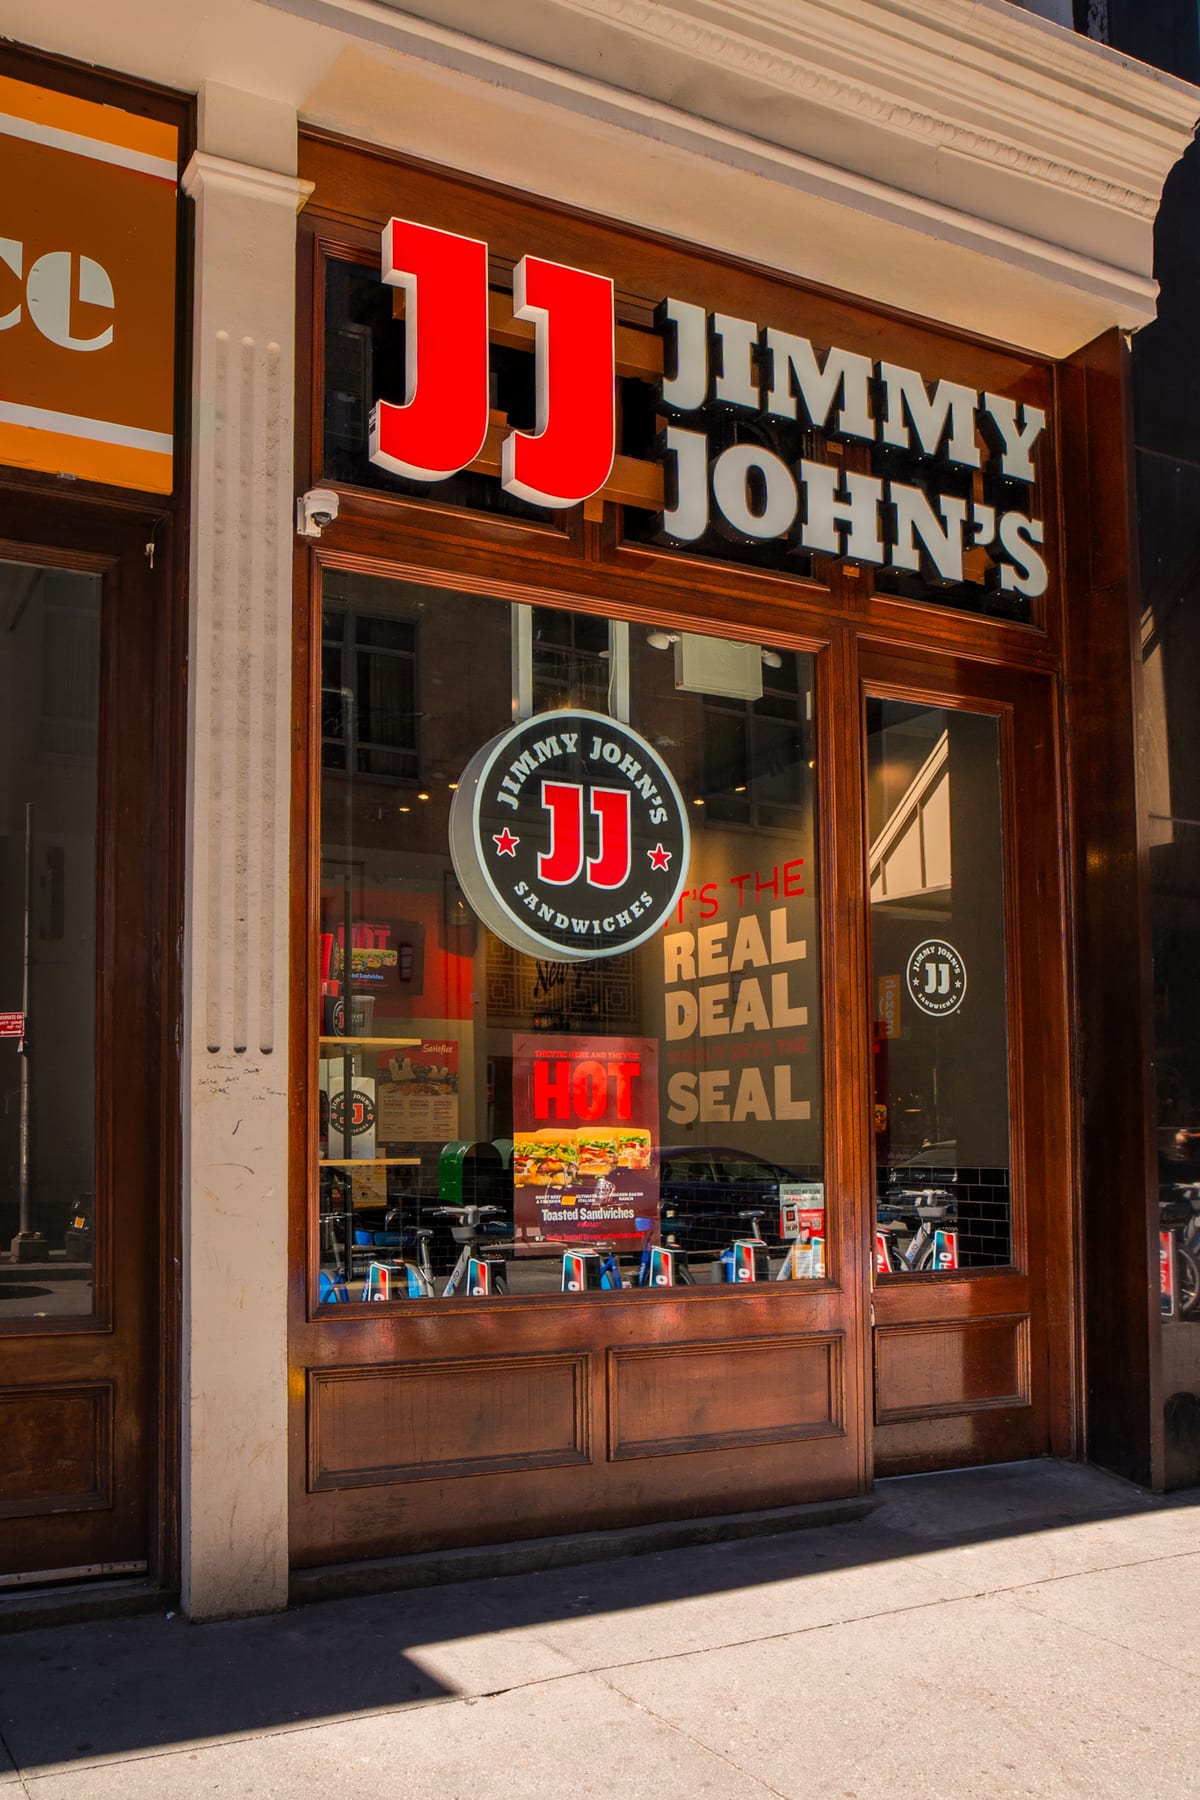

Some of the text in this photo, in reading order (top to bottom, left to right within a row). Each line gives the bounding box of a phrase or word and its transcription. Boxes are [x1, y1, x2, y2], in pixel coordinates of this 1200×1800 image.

[0, 236, 115, 351] e
[369, 217, 614, 508] JJ
[661, 297, 1046, 483] JIMMY
[661, 426, 1047, 598] JOHN'S
[497, 733, 668, 824] JIMMY JOHN'S
[537, 780, 632, 890] JJ
[513, 880, 653, 934] SANDWICHES
[664, 858, 805, 927] T'S THE
[664, 907, 807, 984] REAL
[913, 946, 960, 974] JIMMY JOHN'S
[924, 962, 950, 994] JJ
[665, 972, 808, 1041] DEAL
[918, 993, 957, 1010] SANDWICHES
[777, 1037, 811, 1057] THE
[534, 1060, 641, 1121] HOT
[667, 1064, 811, 1125] SEAL
[542, 1206, 635, 1221] Toasted Sandwiches
